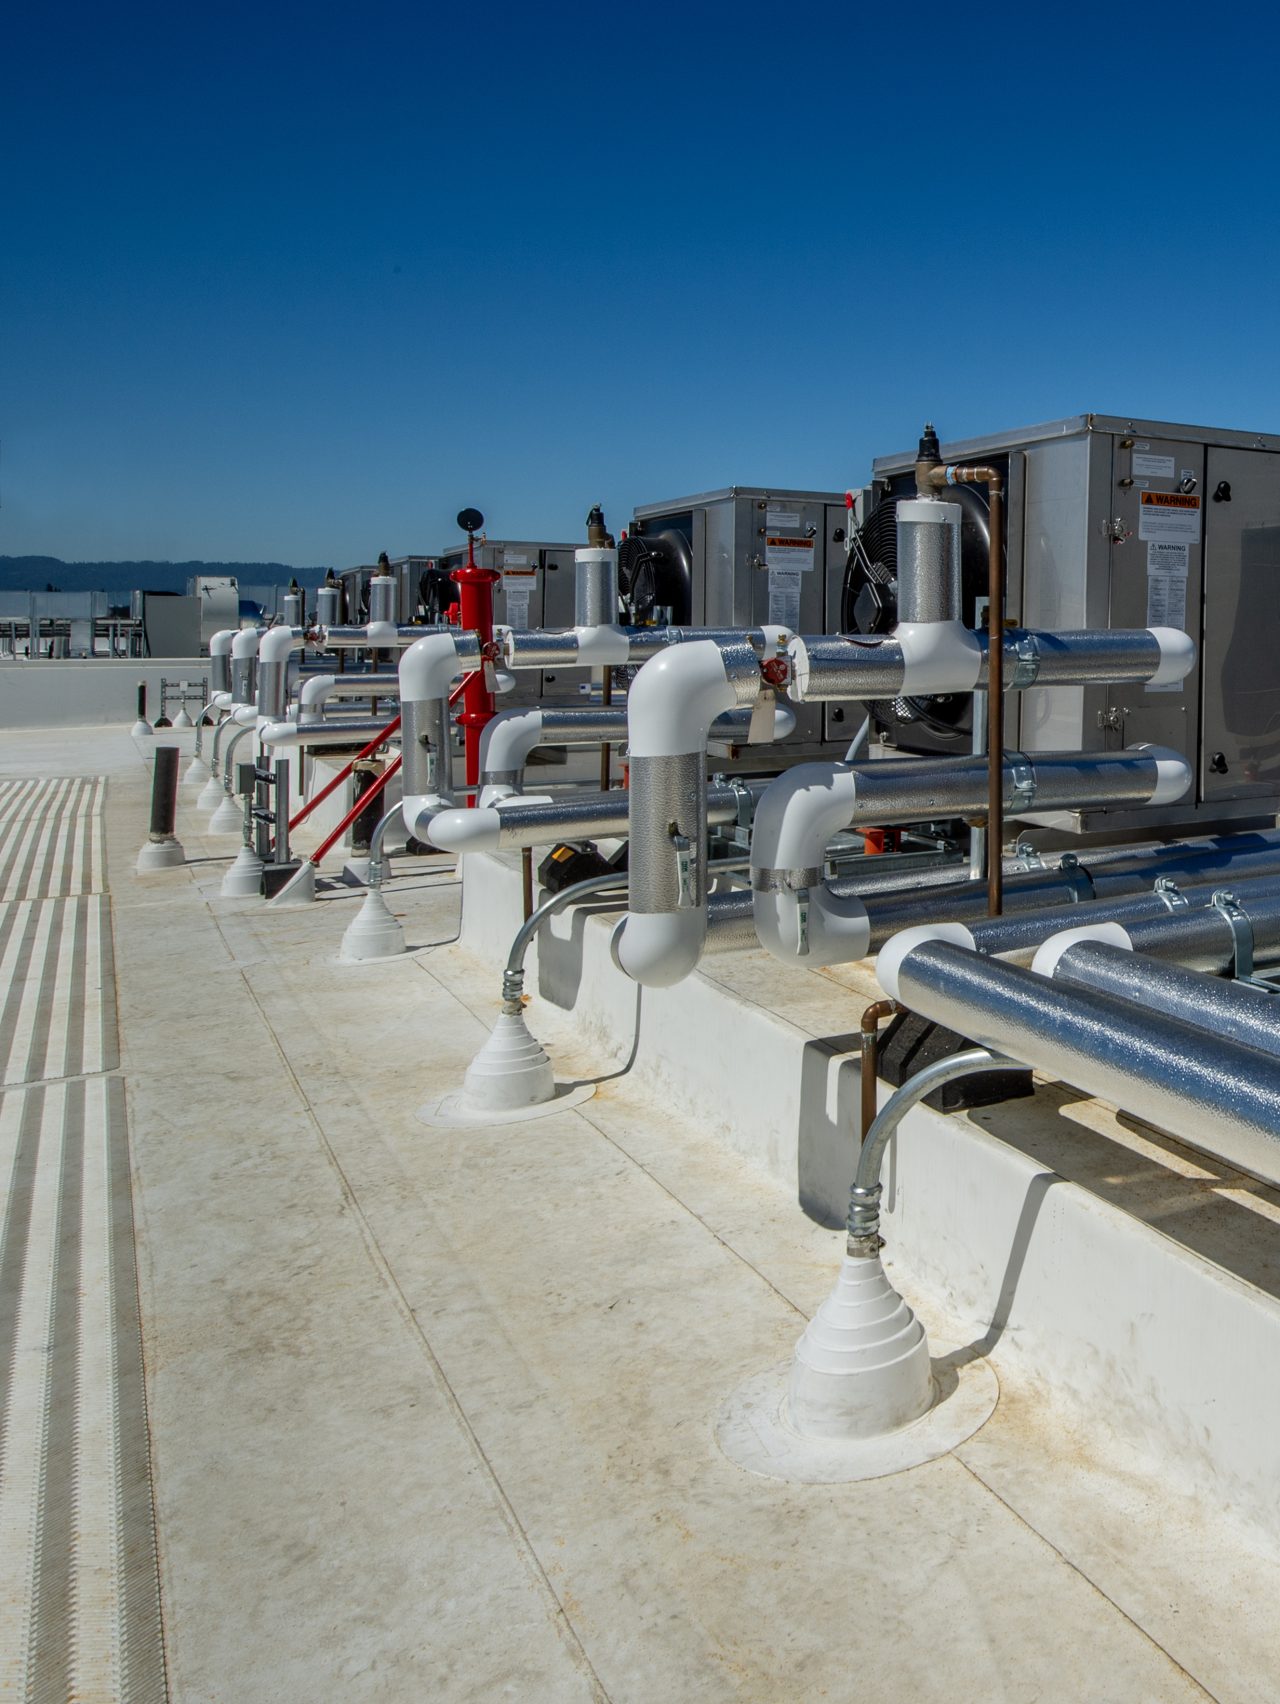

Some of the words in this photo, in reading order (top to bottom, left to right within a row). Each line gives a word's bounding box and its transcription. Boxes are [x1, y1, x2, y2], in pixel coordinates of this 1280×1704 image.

[1156, 494, 1197, 507] WARNING
[777, 538, 812, 548] WARNING
[1158, 544, 1186, 552] WARNING
